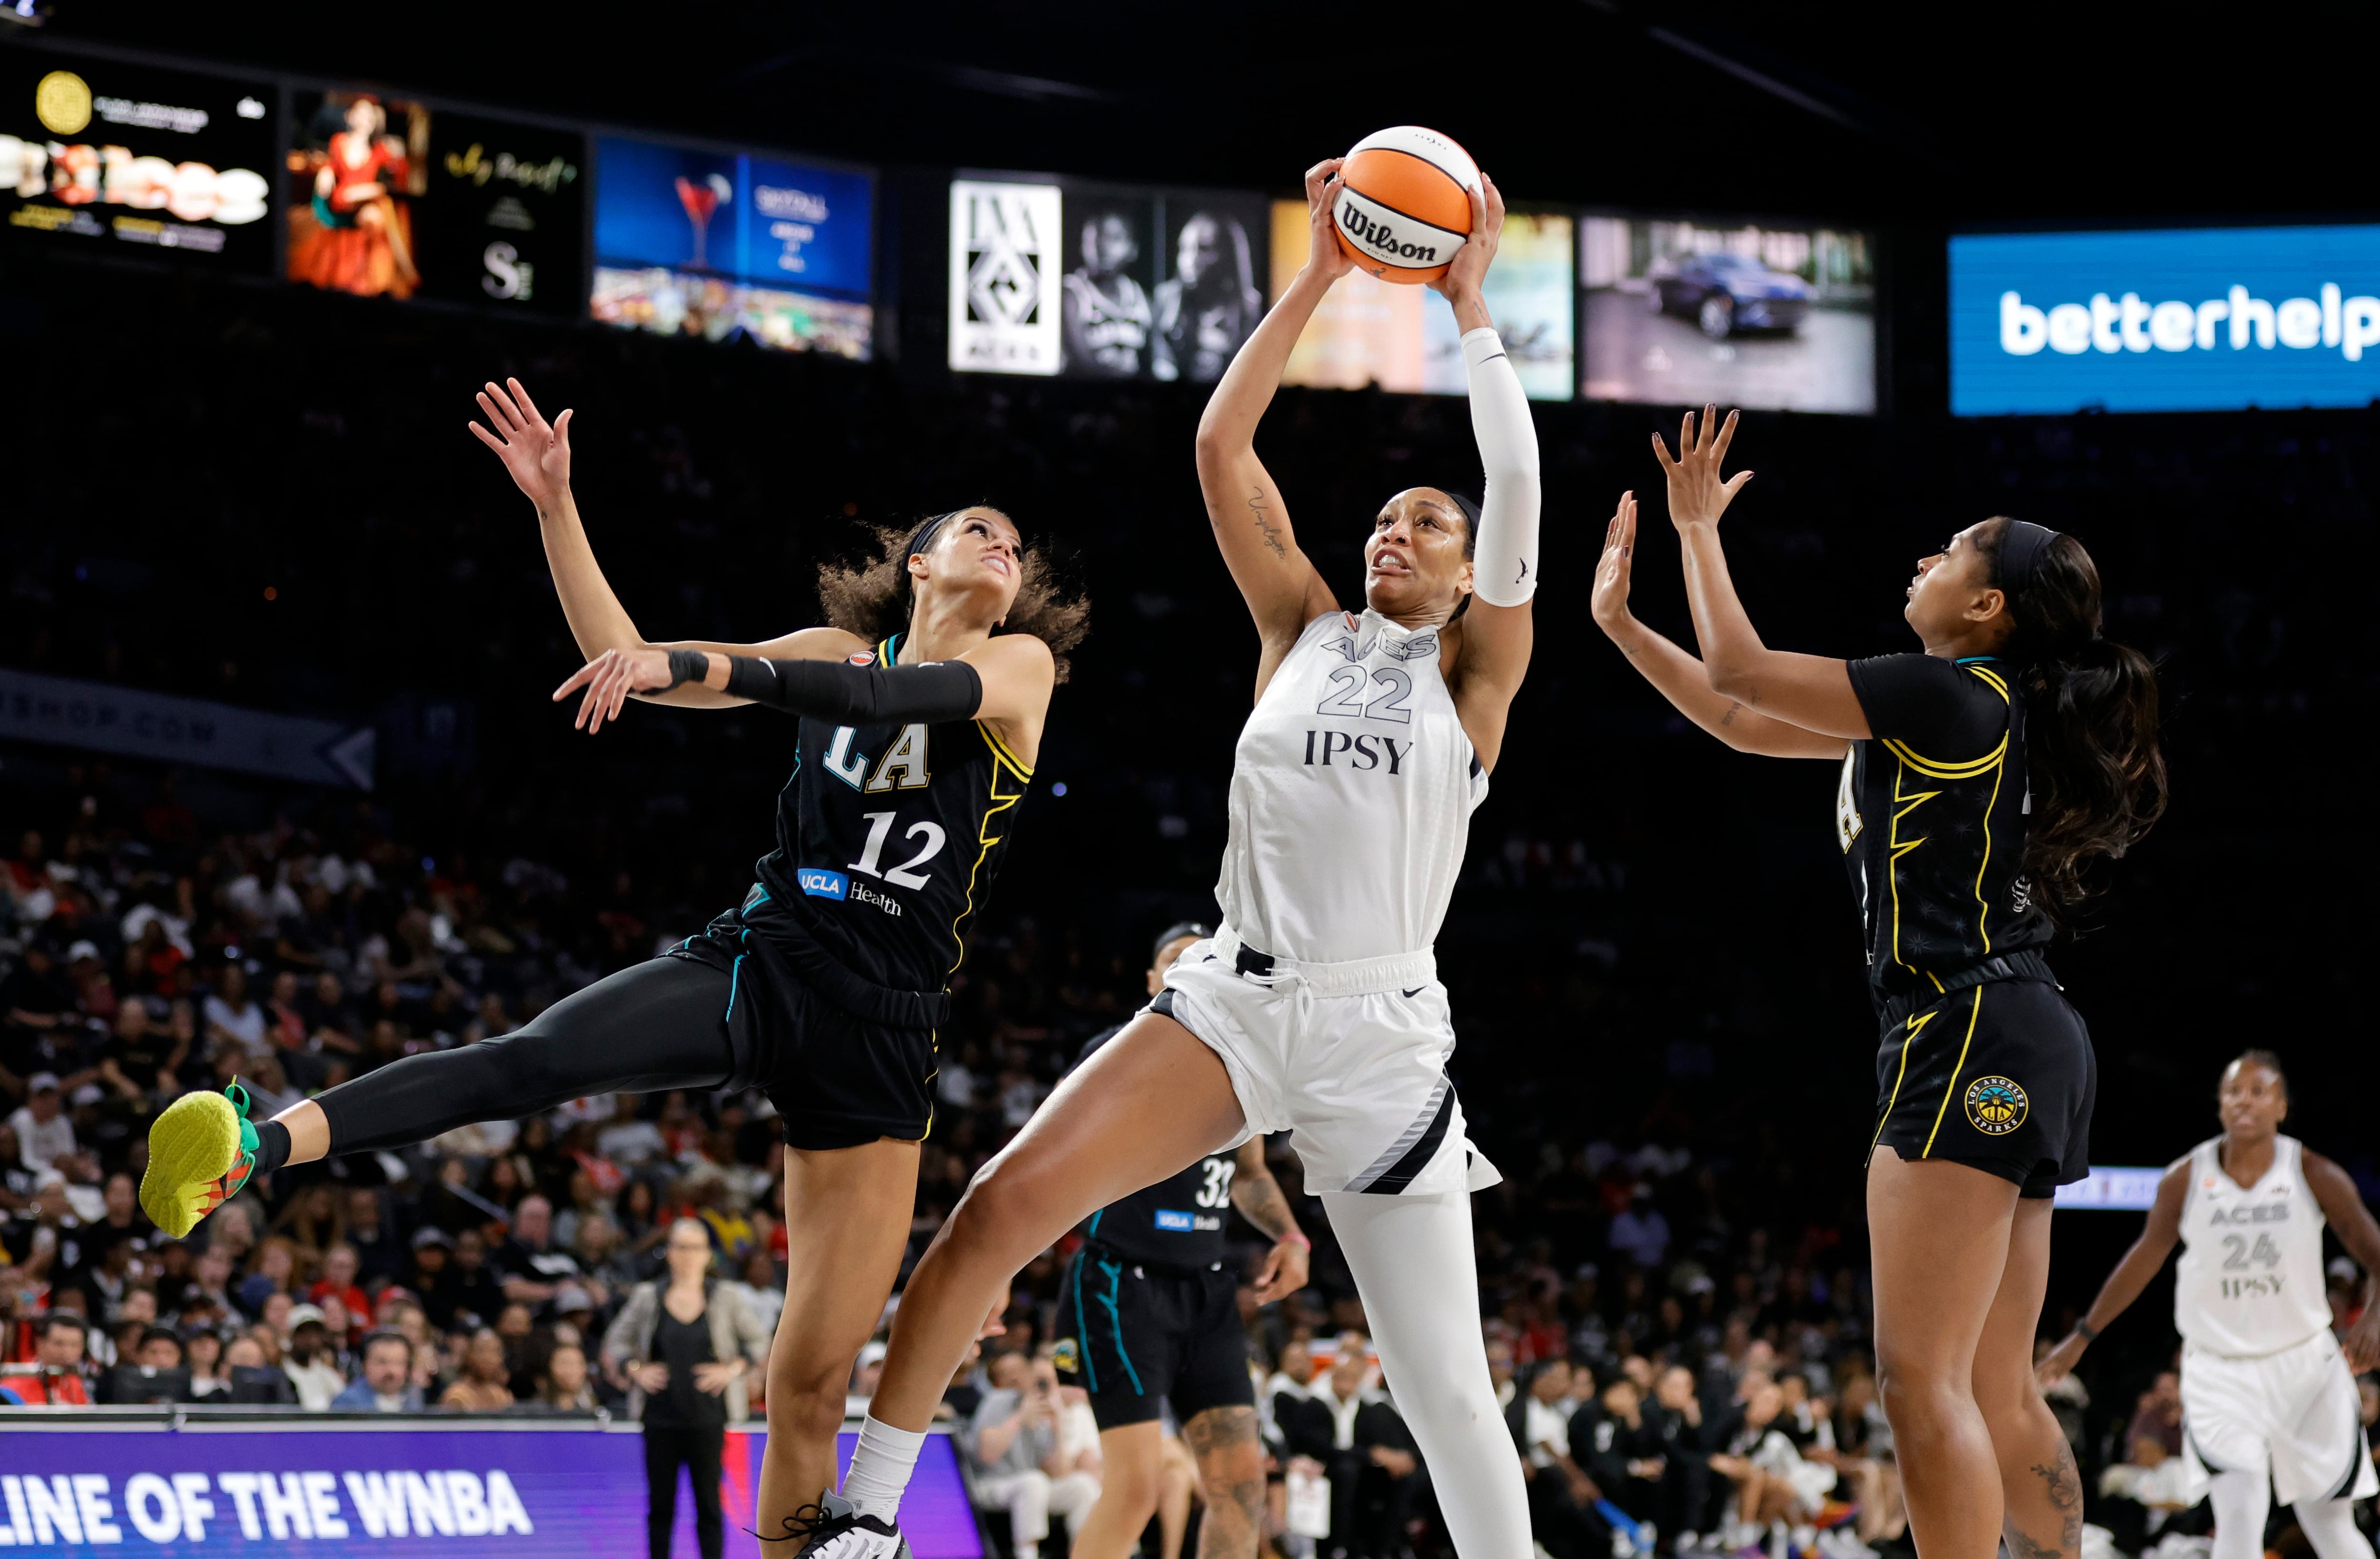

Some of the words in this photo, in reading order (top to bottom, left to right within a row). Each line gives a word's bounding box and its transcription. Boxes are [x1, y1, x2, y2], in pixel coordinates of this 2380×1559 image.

[1343, 199, 1437, 262] Wilson
[2000, 282, 2380, 362] betterhelp
[1320, 628, 1437, 663] ACES
[1317, 665, 1412, 724] 22
[823, 723, 932, 794] LA
[1304, 730, 1414, 775] IPSY
[847, 811, 946, 891] 12
[801, 875, 840, 894] UCLA
[849, 881, 902, 917] Health
[1968, 1085, 1980, 1105] LOS
[1983, 1078, 2025, 1107] ANGELES
[1973, 1116, 2018, 1132] SPARKS
[1195, 1157, 1237, 1209] 32
[2209, 1202, 2291, 1226] ACES
[2221, 1232, 2284, 1270] 24
[0, 1474, 123, 1546] INE
[124, 1471, 216, 1544] OF
[217, 1470, 350, 1541] THE
[341, 1468, 535, 1538] WNBA
